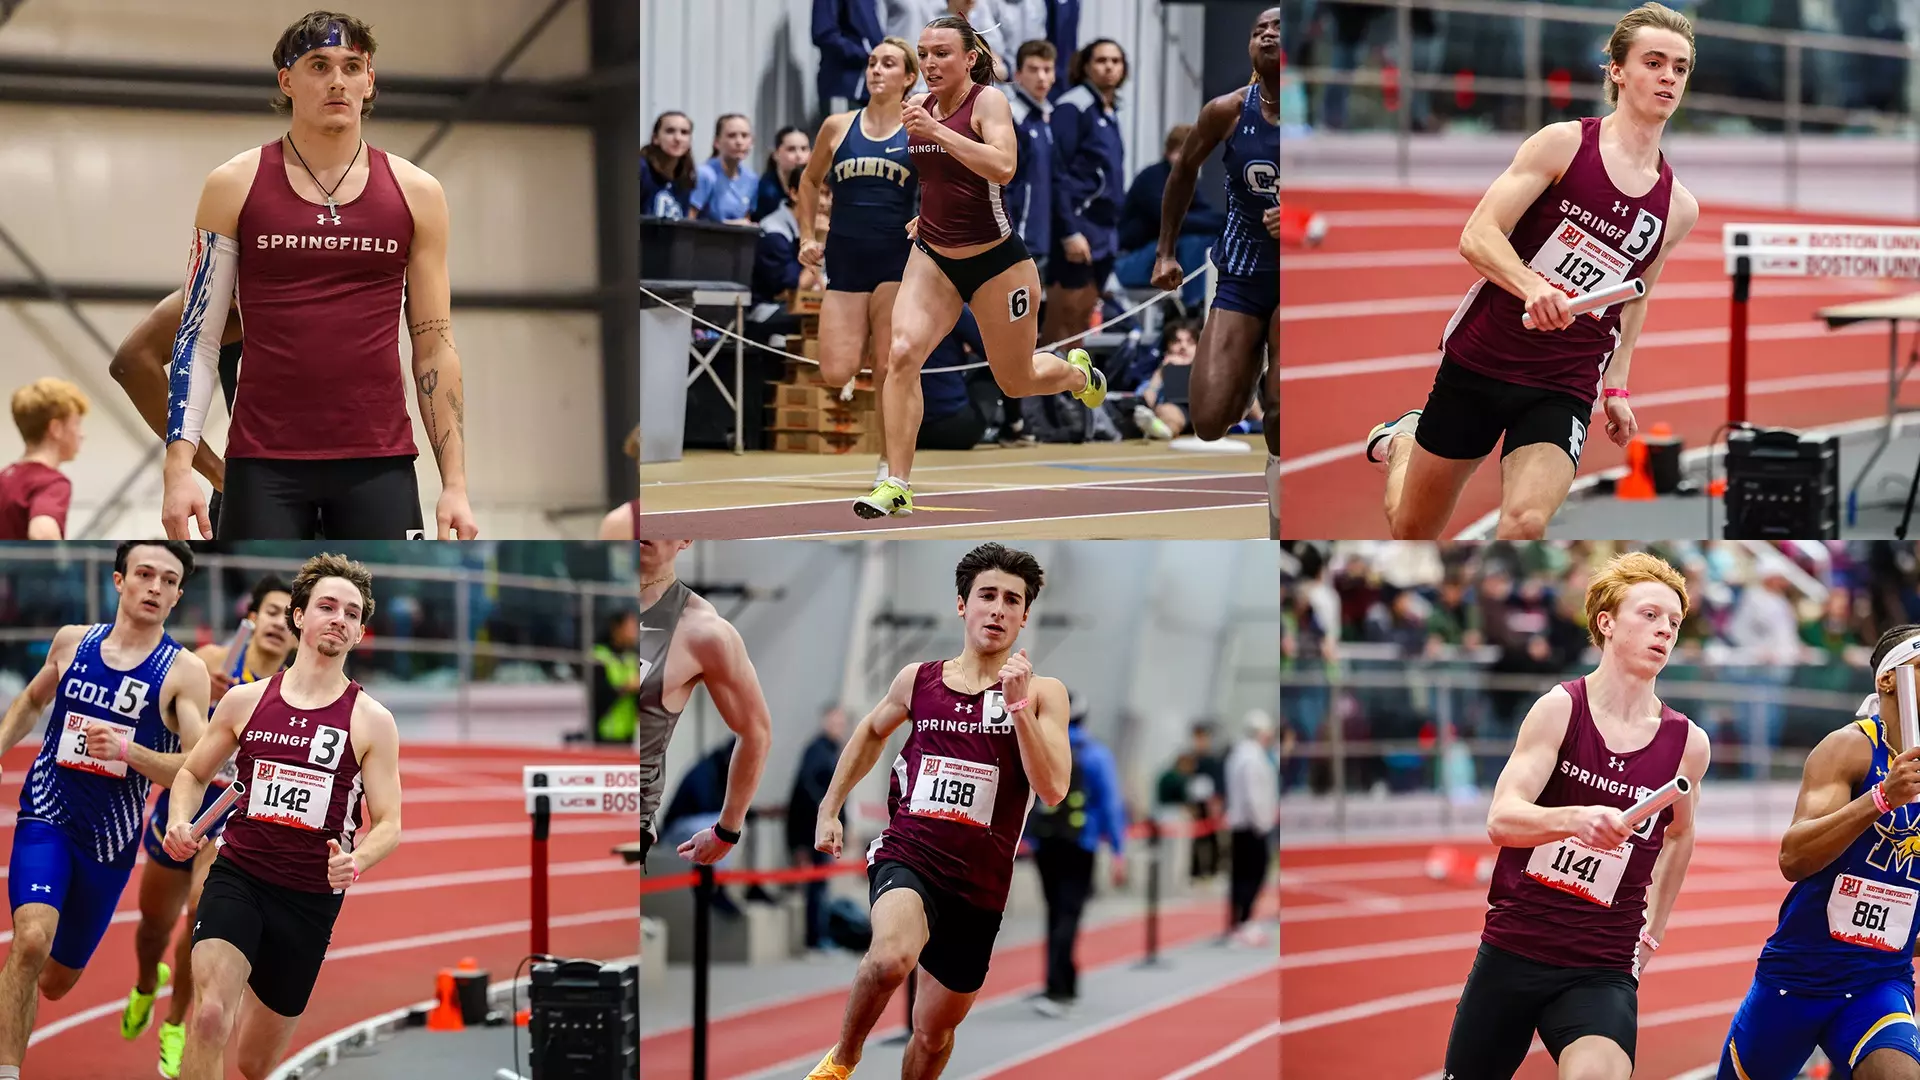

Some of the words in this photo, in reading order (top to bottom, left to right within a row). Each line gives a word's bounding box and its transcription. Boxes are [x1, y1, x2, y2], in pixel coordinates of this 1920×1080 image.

[834, 156, 911, 187] TRINITY
[1559, 199, 1627, 240] SPRINGF
[257, 235, 398, 254] SPRINGFIELD
[1560, 224, 1586, 248] BU
[1627, 215, 1656, 255] 3
[1808, 232, 1878, 249] BOSTON
[1554, 252, 1606, 293] 1137
[1012, 289, 1027, 317] 6
[119, 681, 143, 713] 5
[991, 692, 1008, 724] 5
[246, 730, 310, 747] SPRINGF
[917, 719, 1012, 734] SPRINGFIELD
[315, 729, 340, 765] 3
[258, 763, 276, 779] BU
[605, 771, 640, 787] BOS
[924, 758, 941, 773] BU
[1560, 760, 1641, 799] SPRINGFIE
[264, 783, 311, 813] 1142
[603, 791, 640, 812] BOS
[930, 778, 976, 807] 1138
[1551, 845, 1602, 883] 1141
[1840, 876, 1863, 895] BU
[1852, 901, 1890, 932] 861
